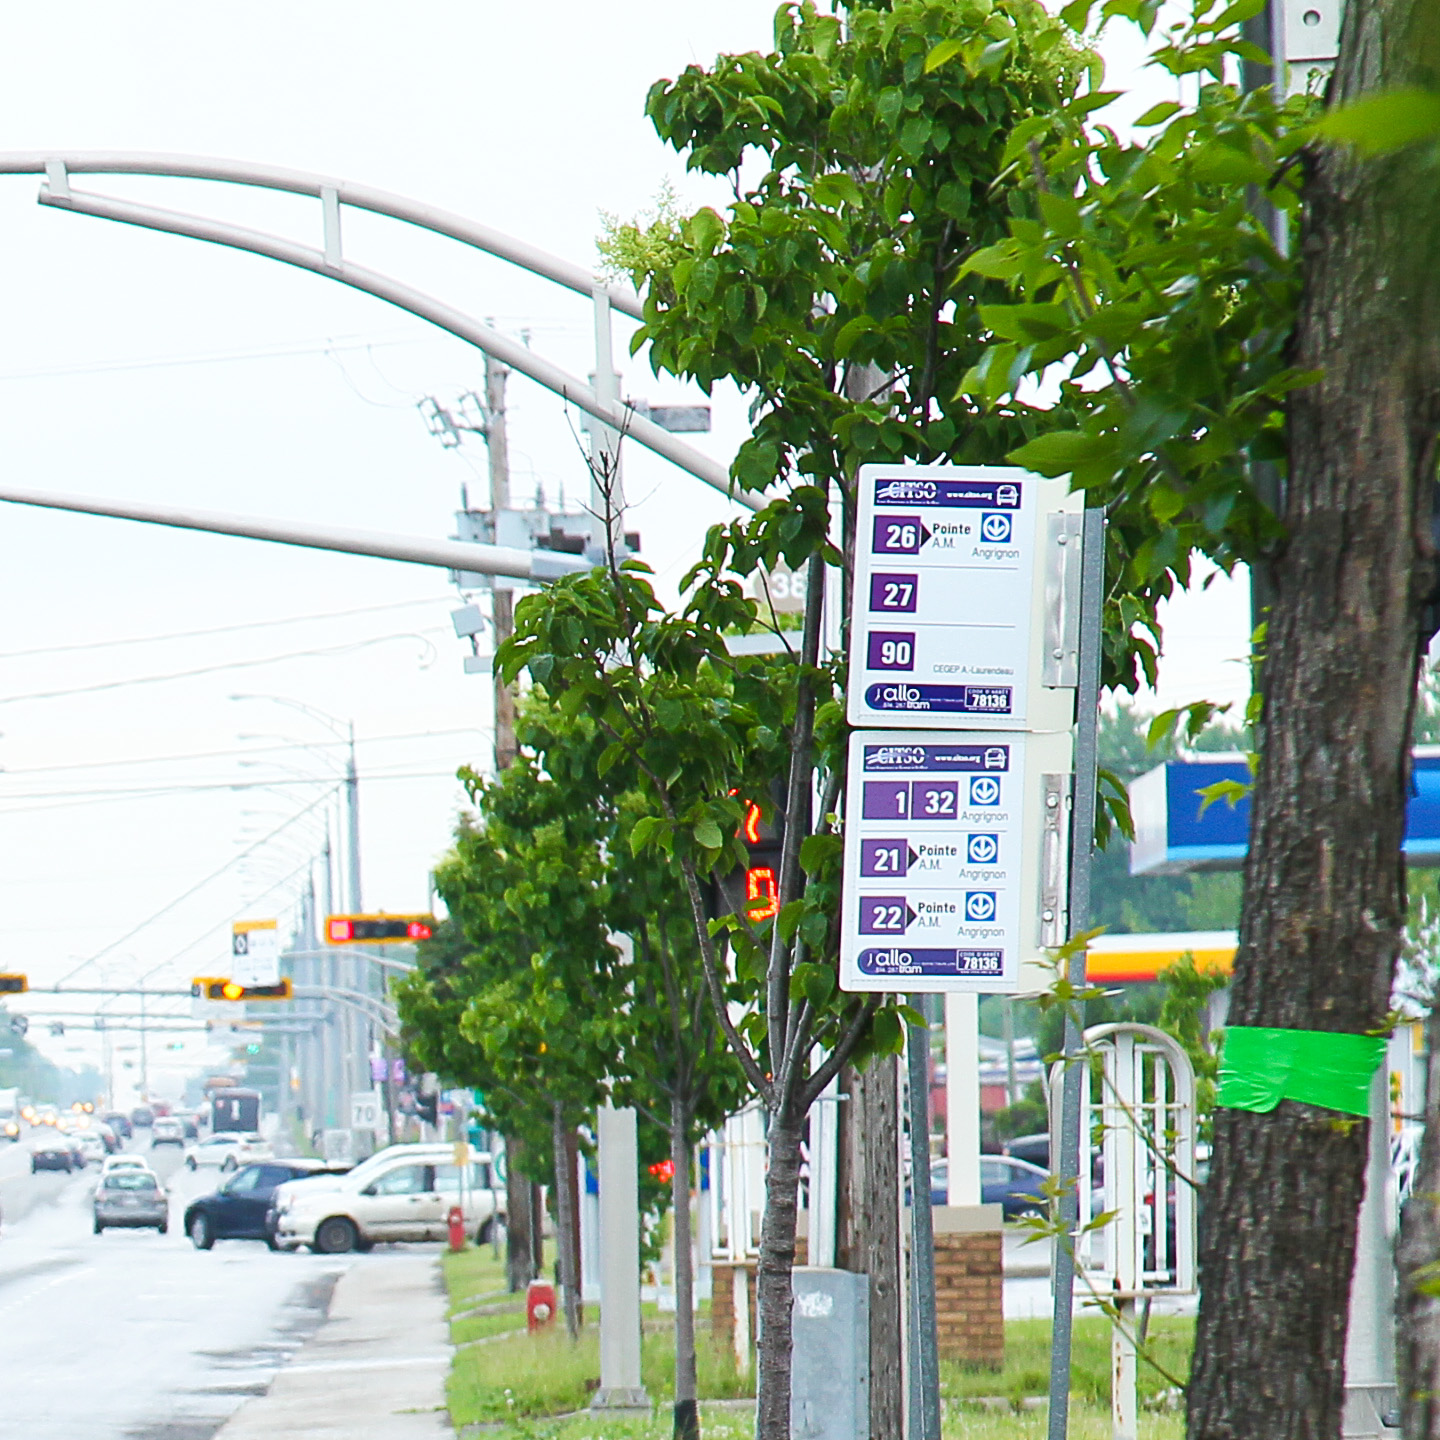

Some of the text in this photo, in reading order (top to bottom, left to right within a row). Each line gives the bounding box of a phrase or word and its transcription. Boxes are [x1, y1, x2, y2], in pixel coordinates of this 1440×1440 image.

[932, 523, 971, 535] Pointe
[886, 524, 917, 549] 26
[932, 537, 956, 549] A.M.
[972, 547, 1020, 560] Angrignon
[883, 583, 913, 607] 27
[881, 641, 911, 665] 90
[883, 684, 920, 702] allo
[971, 694, 1007, 707] 78136
[895, 791, 954, 814] 1 32
[961, 810, 1009, 823] Angrignon
[919, 845, 957, 857] Pointe
[874, 848, 899, 871] 21
[919, 859, 942, 871] A.M.
[959, 868, 1006, 881] Angrignon
[918, 902, 956, 914] Pointe
[872, 906, 902, 929] 22
[917, 916, 941, 928] A.M.
[957, 926, 1005, 939] Angrignon
[875, 949, 912, 966] allo
[963, 957, 998, 970] 78136
